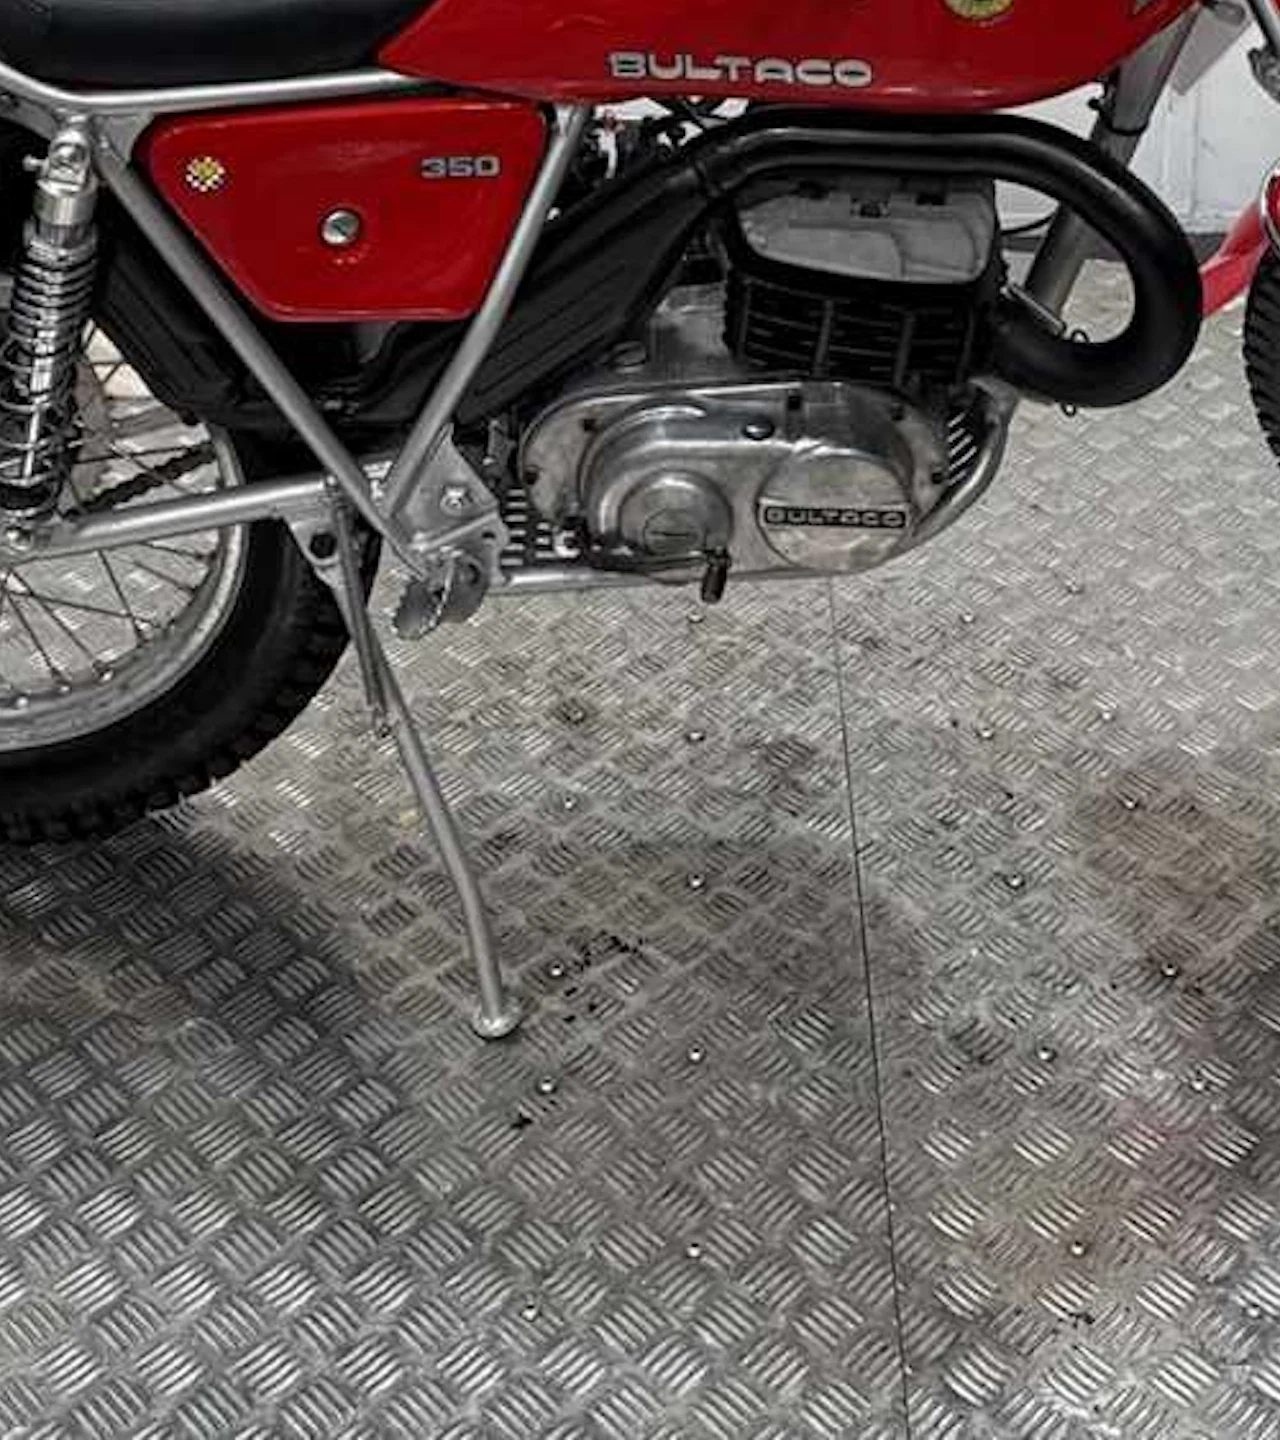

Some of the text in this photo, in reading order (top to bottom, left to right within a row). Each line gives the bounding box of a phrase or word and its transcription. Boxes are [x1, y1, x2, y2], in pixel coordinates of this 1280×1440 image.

[609, 51, 872, 87] BULTACO
[421, 156, 499, 177] 350
[768, 509, 903, 527] BULTACO
